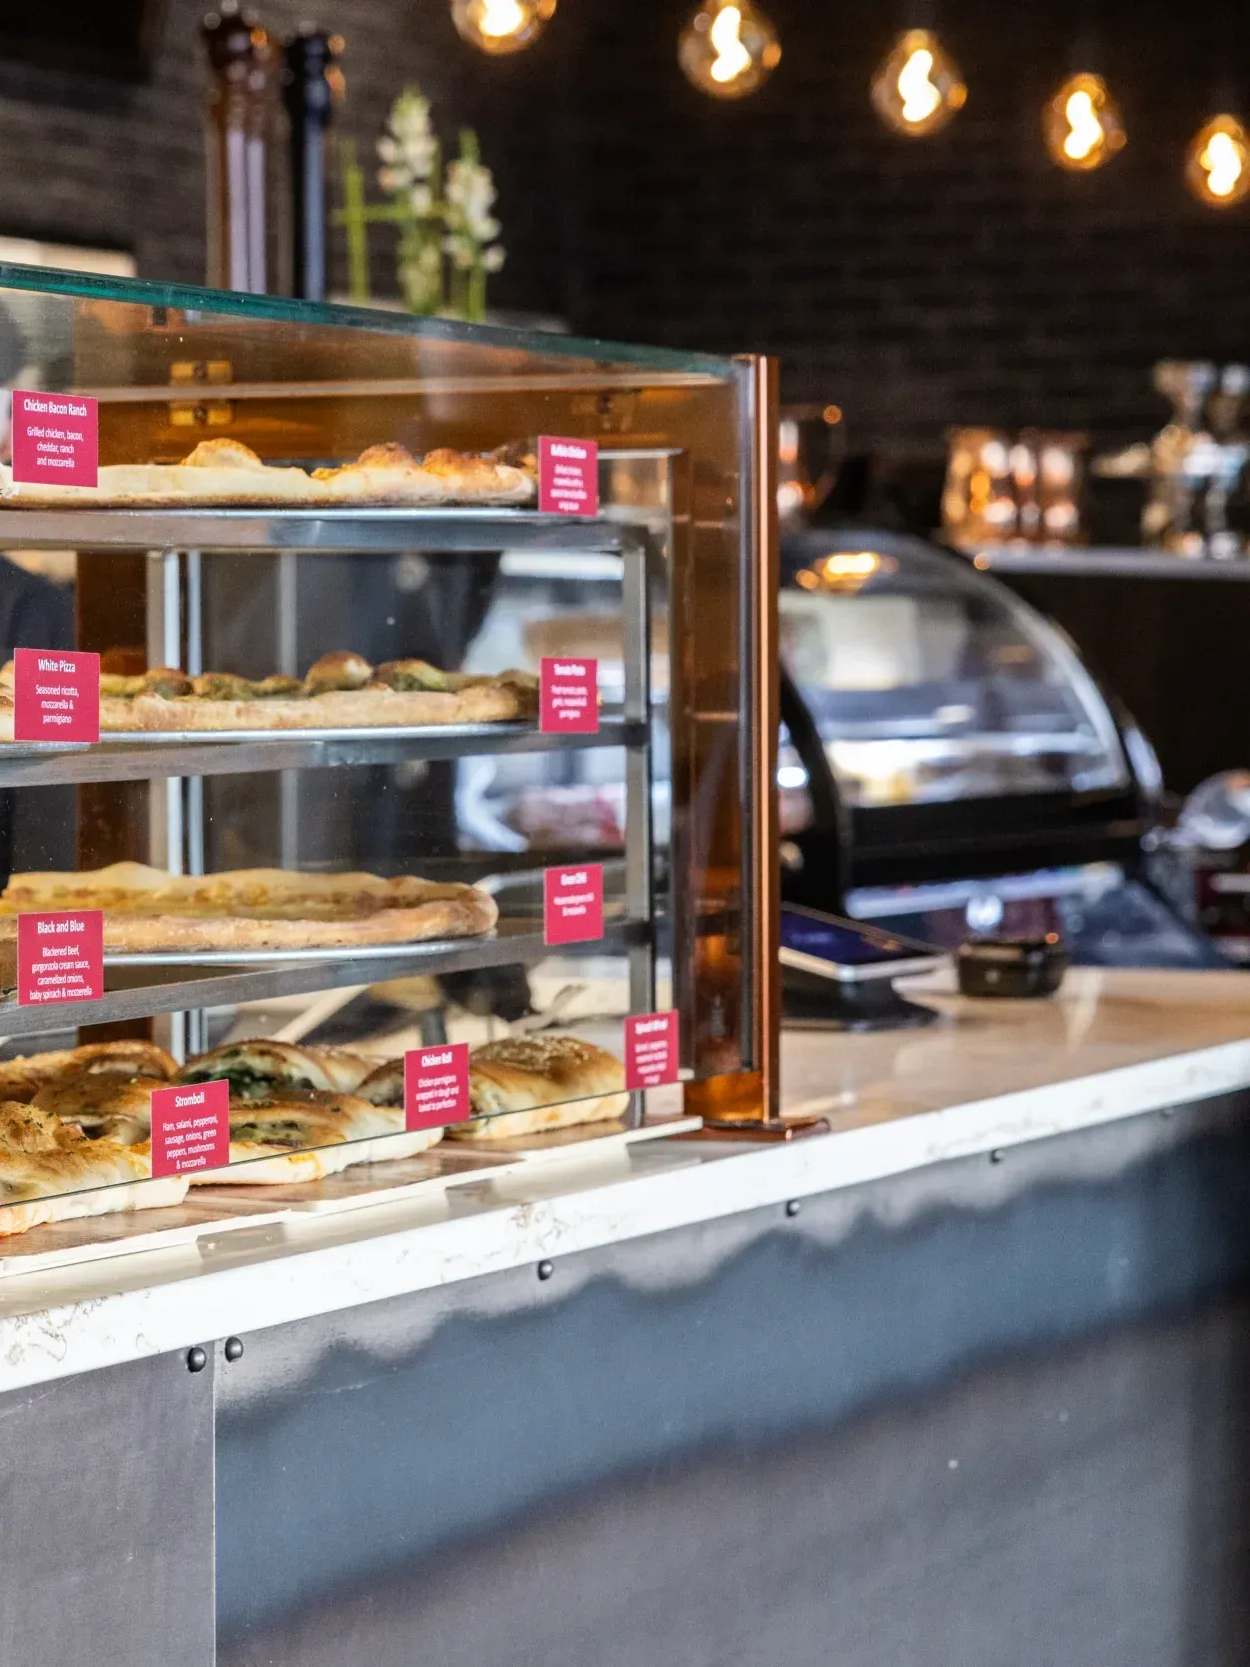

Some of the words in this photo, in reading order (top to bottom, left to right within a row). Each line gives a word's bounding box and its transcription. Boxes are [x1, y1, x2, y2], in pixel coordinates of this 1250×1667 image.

[24, 398, 48, 413] Chicken
[49, 401, 67, 415] Bacon
[68, 403, 87, 416] Ranch
[27, 426, 45, 437] Grilled
[45, 428, 65, 440] chicken,
[67, 430, 84, 442] bacon,
[37, 441, 59, 454] cheddar,
[60, 444, 74, 453] ranch
[37, 456, 47, 465] and
[48, 459, 74, 468] mozzarella
[38, 659, 58, 671] White
[59, 660, 76, 673] Pizza
[35, 684, 60, 695] Seasoned
[61, 686, 79, 697] ricotta,
[41, 699, 68, 709] mozzarella
[69, 700, 74, 709] &
[43, 714, 72, 725] parmigiano
[37, 920, 55, 934] Black
[56, 920, 69, 932] and
[69, 920, 85, 931] Blue
[42, 946, 67, 957] Blackened
[67, 945, 80, 956] Beef,
[31, 961, 58, 974] gorgonzola
[59, 961, 74, 970] cream
[74, 960, 90, 969] sauce,
[37, 974, 67, 985] caramelized
[67, 973, 84, 983] onions,
[29, 989, 42, 1001] baby
[43, 988, 61, 1000] spinach
[62, 988, 66, 997] &
[175, 1092, 205, 1107] Stromboli
[162, 1122, 175, 1131] Ham,
[176, 1118, 192, 1129] salami,
[193, 1114, 218, 1128] pepperoni,
[165, 1135, 185, 1145] sausage,
[185, 1131, 202, 1141] onions,
[203, 1129, 217, 1140] green
[166, 1148, 187, 1160] peppers,
[188, 1143, 215, 1154] mushrooms
[176, 1160, 180, 1170] &
